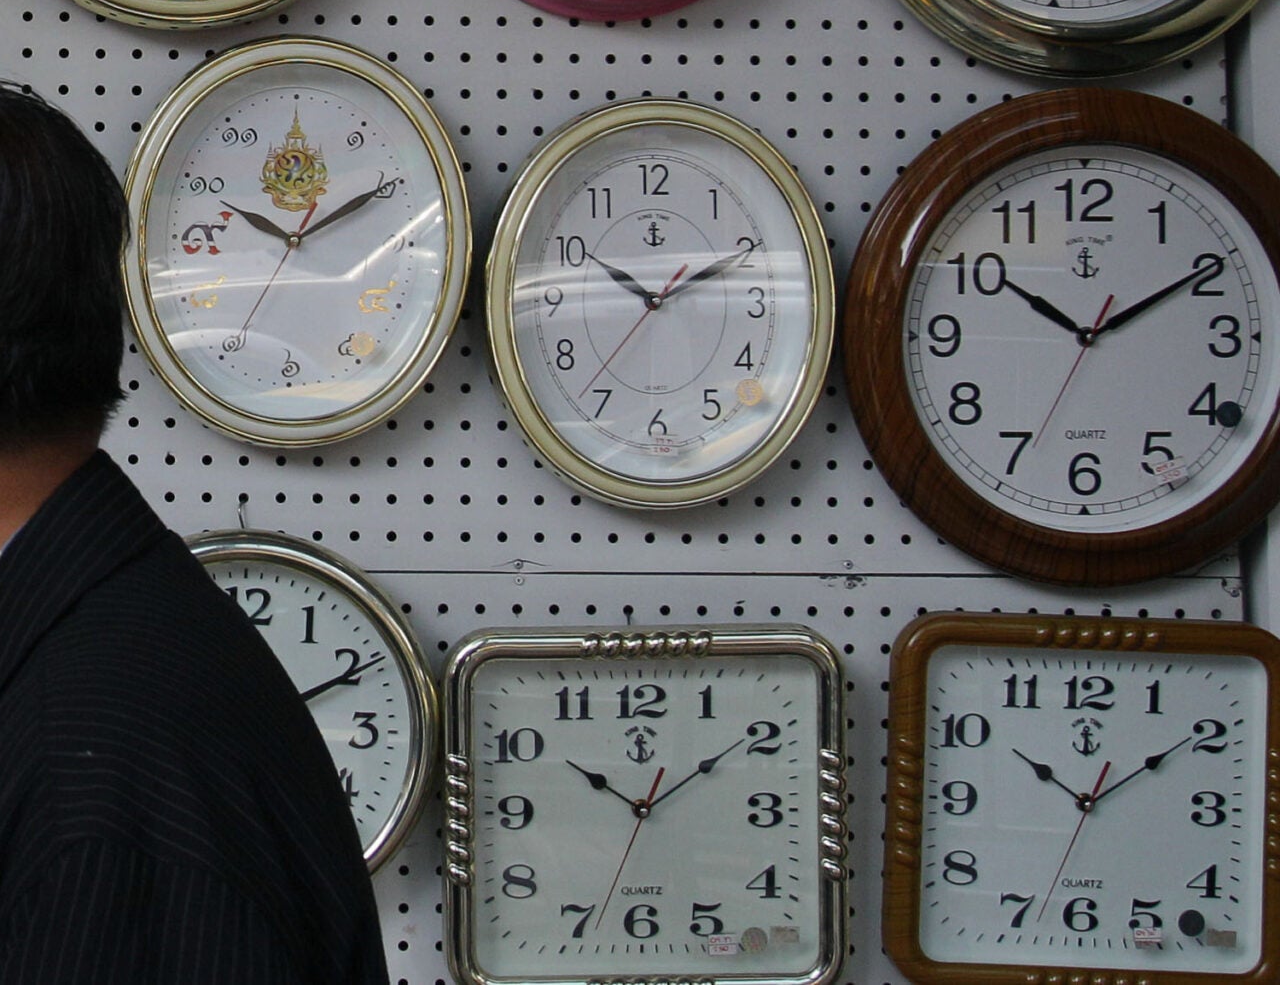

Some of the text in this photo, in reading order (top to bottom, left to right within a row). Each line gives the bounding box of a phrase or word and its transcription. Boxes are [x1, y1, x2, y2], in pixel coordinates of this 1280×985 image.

[638, 164, 669, 195] 12
[587, 188, 610, 218] 11
[1055, 178, 1113, 222] 12
[992, 200, 1036, 244] 11
[556, 235, 585, 267] 10
[947, 252, 1006, 295] 10
[928, 314, 962, 358] 9
[734, 341, 754, 371] 4
[702, 389, 721, 420] 5
[948, 381, 982, 425] 8
[1065, 430, 1106, 440] QUARTZ
[300, 606, 318, 644] 1
[335, 648, 362, 685] 2
[616, 684, 667, 718] 12
[1002, 674, 1040, 709] 11
[1063, 676, 1115, 711] 12
[349, 712, 379, 749] 3
[494, 727, 544, 763] 10
[746, 721, 782, 754] 2
[940, 713, 991, 748] 10
[1192, 719, 1227, 754] 2
[498, 795, 534, 830] 9
[747, 792, 783, 827] 3
[1191, 791, 1226, 827] 3
[621, 886, 662, 894] QUARTZ
[1062, 879, 1102, 888] QUARTZ
